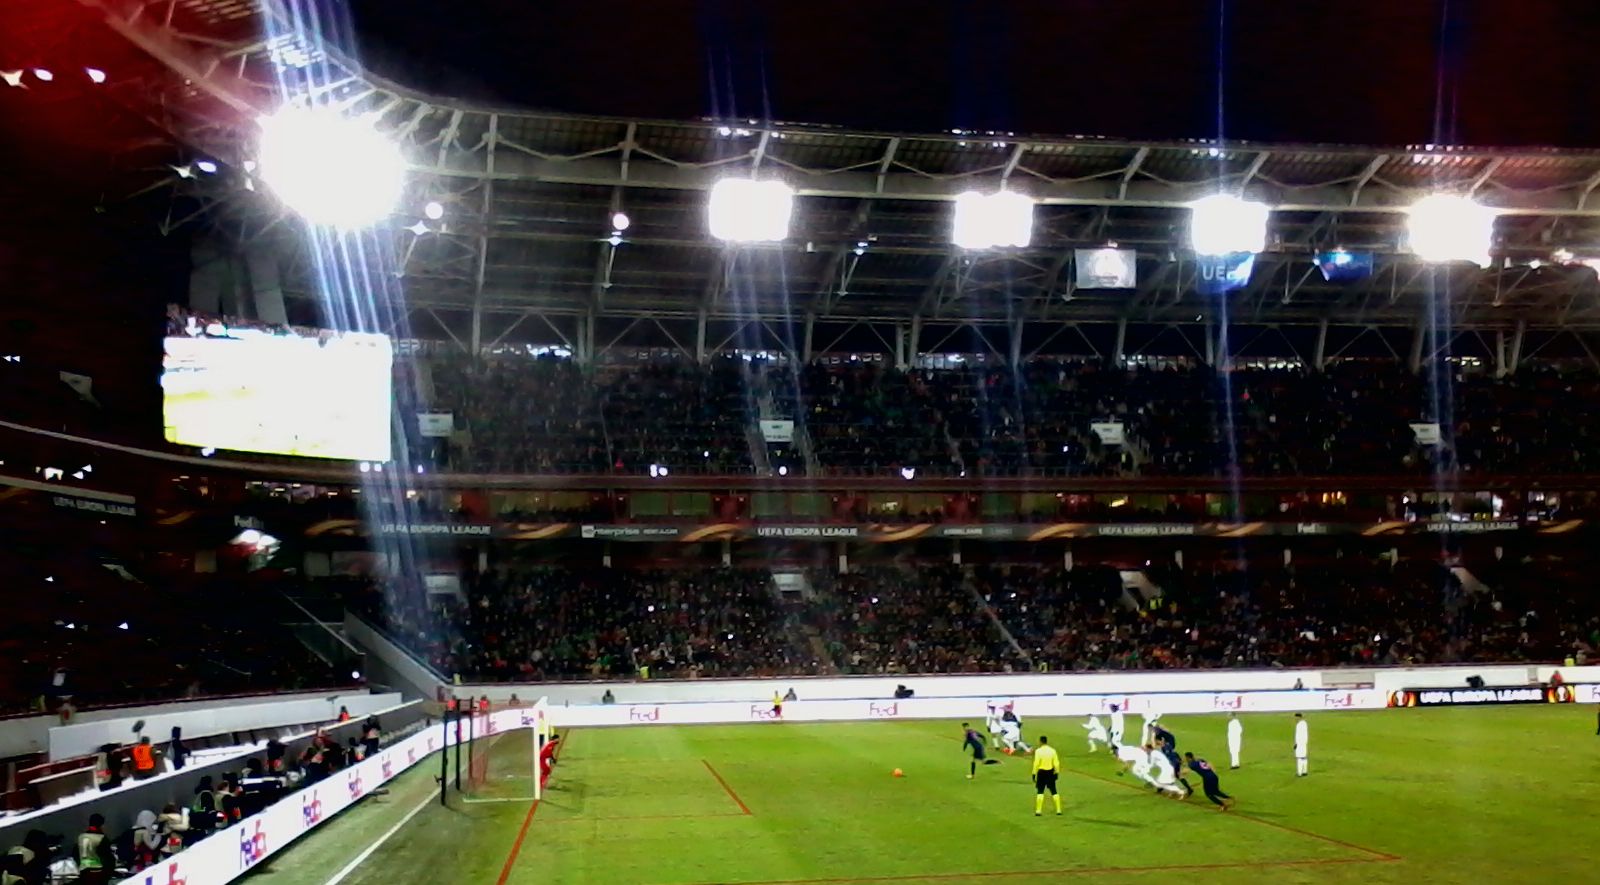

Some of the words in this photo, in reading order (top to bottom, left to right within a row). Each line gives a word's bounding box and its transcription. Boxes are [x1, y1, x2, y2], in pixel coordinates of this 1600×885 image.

[381, 523, 409, 534] UEFA
[410, 524, 450, 534] EUROPA
[451, 525, 491, 535] LEAGUE
[1098, 526, 1122, 535] UEFA
[1124, 526, 1158, 536] EUROPA
[1159, 526, 1194, 535] LEAGUE
[1427, 522, 1449, 532] UEFA
[1451, 522, 1483, 532] EUROPA
[1485, 521, 1518, 531] LEAGUE
[757, 528, 782, 537] UEFA
[784, 528, 820, 537] EUROPA
[822, 528, 858, 536] LEAGUE
[1420, 691, 1451, 703] UEFA
[1452, 690, 1497, 703] EUROPA
[1498, 688, 1542, 702] LEAGUE
